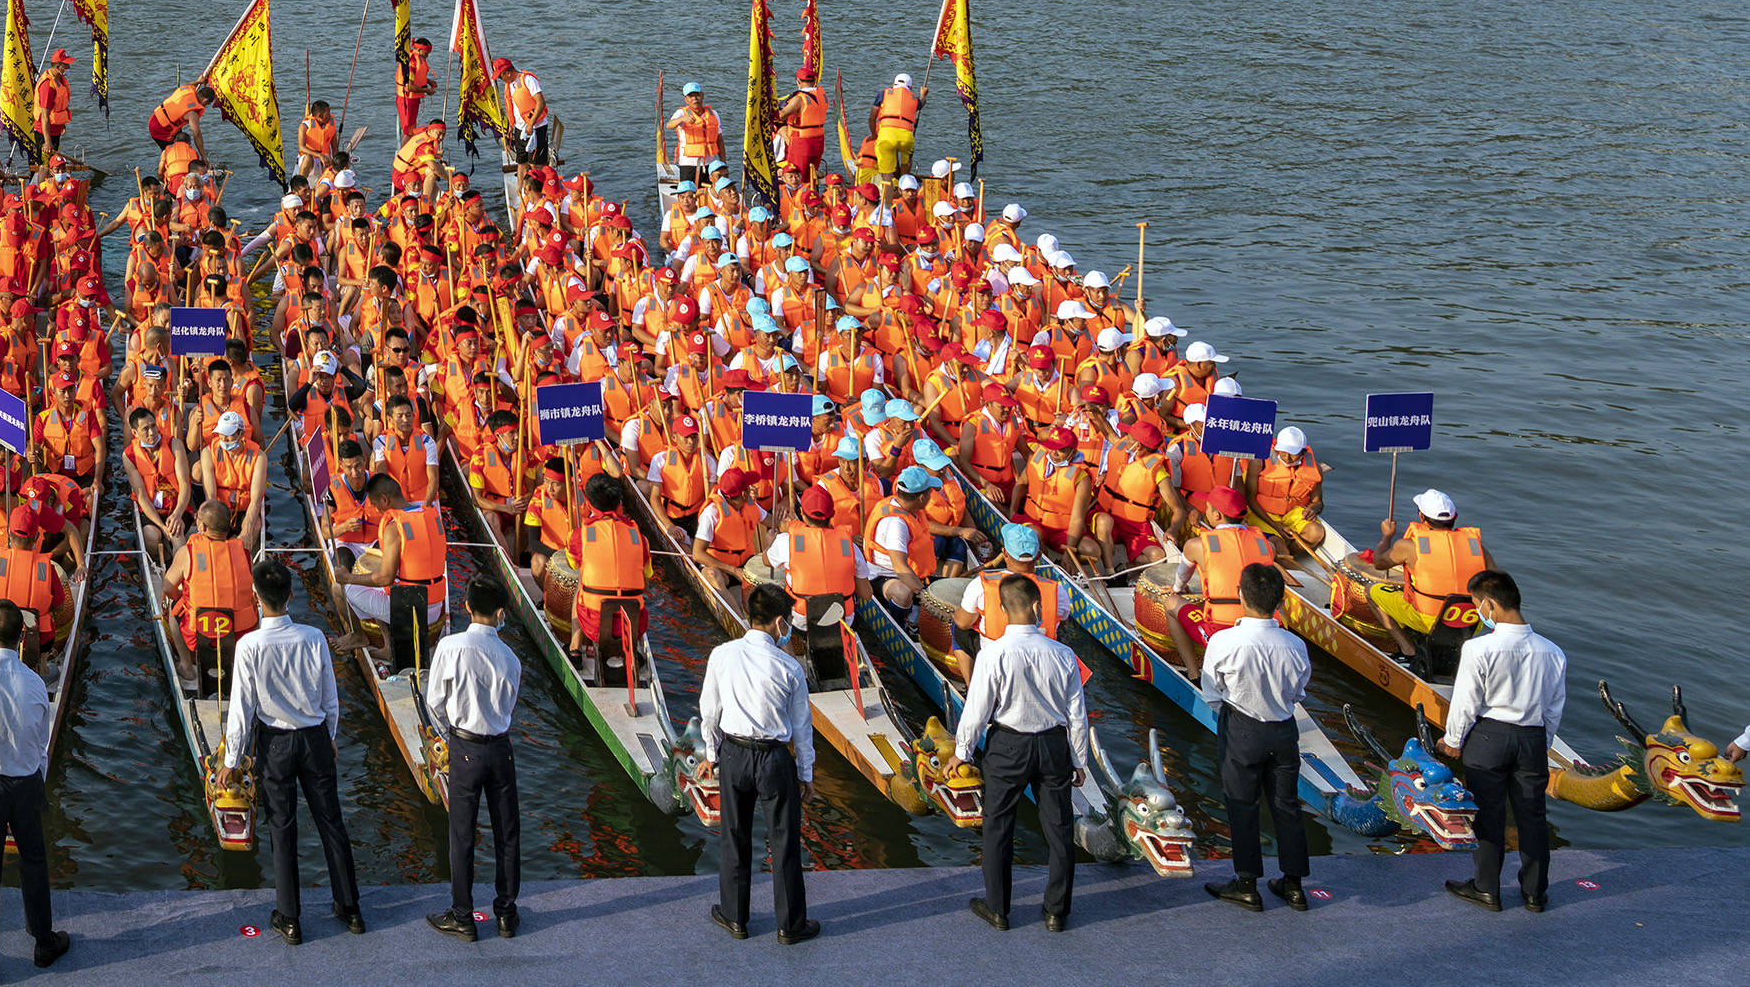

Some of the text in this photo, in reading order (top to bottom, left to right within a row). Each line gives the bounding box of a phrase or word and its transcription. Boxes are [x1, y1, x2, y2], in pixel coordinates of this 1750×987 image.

[171, 326, 225, 336] 赵化镇龙舟队
[539, 404, 602, 421] 狮市镇龙舟队
[744, 413, 812, 427] 李桥镇龙舟队
[1206, 416, 1273, 435] 永年镇龙舟队
[1443, 606, 1479, 624] 06
[198, 616, 230, 633] 12
[244, 926, 256, 936] 3
